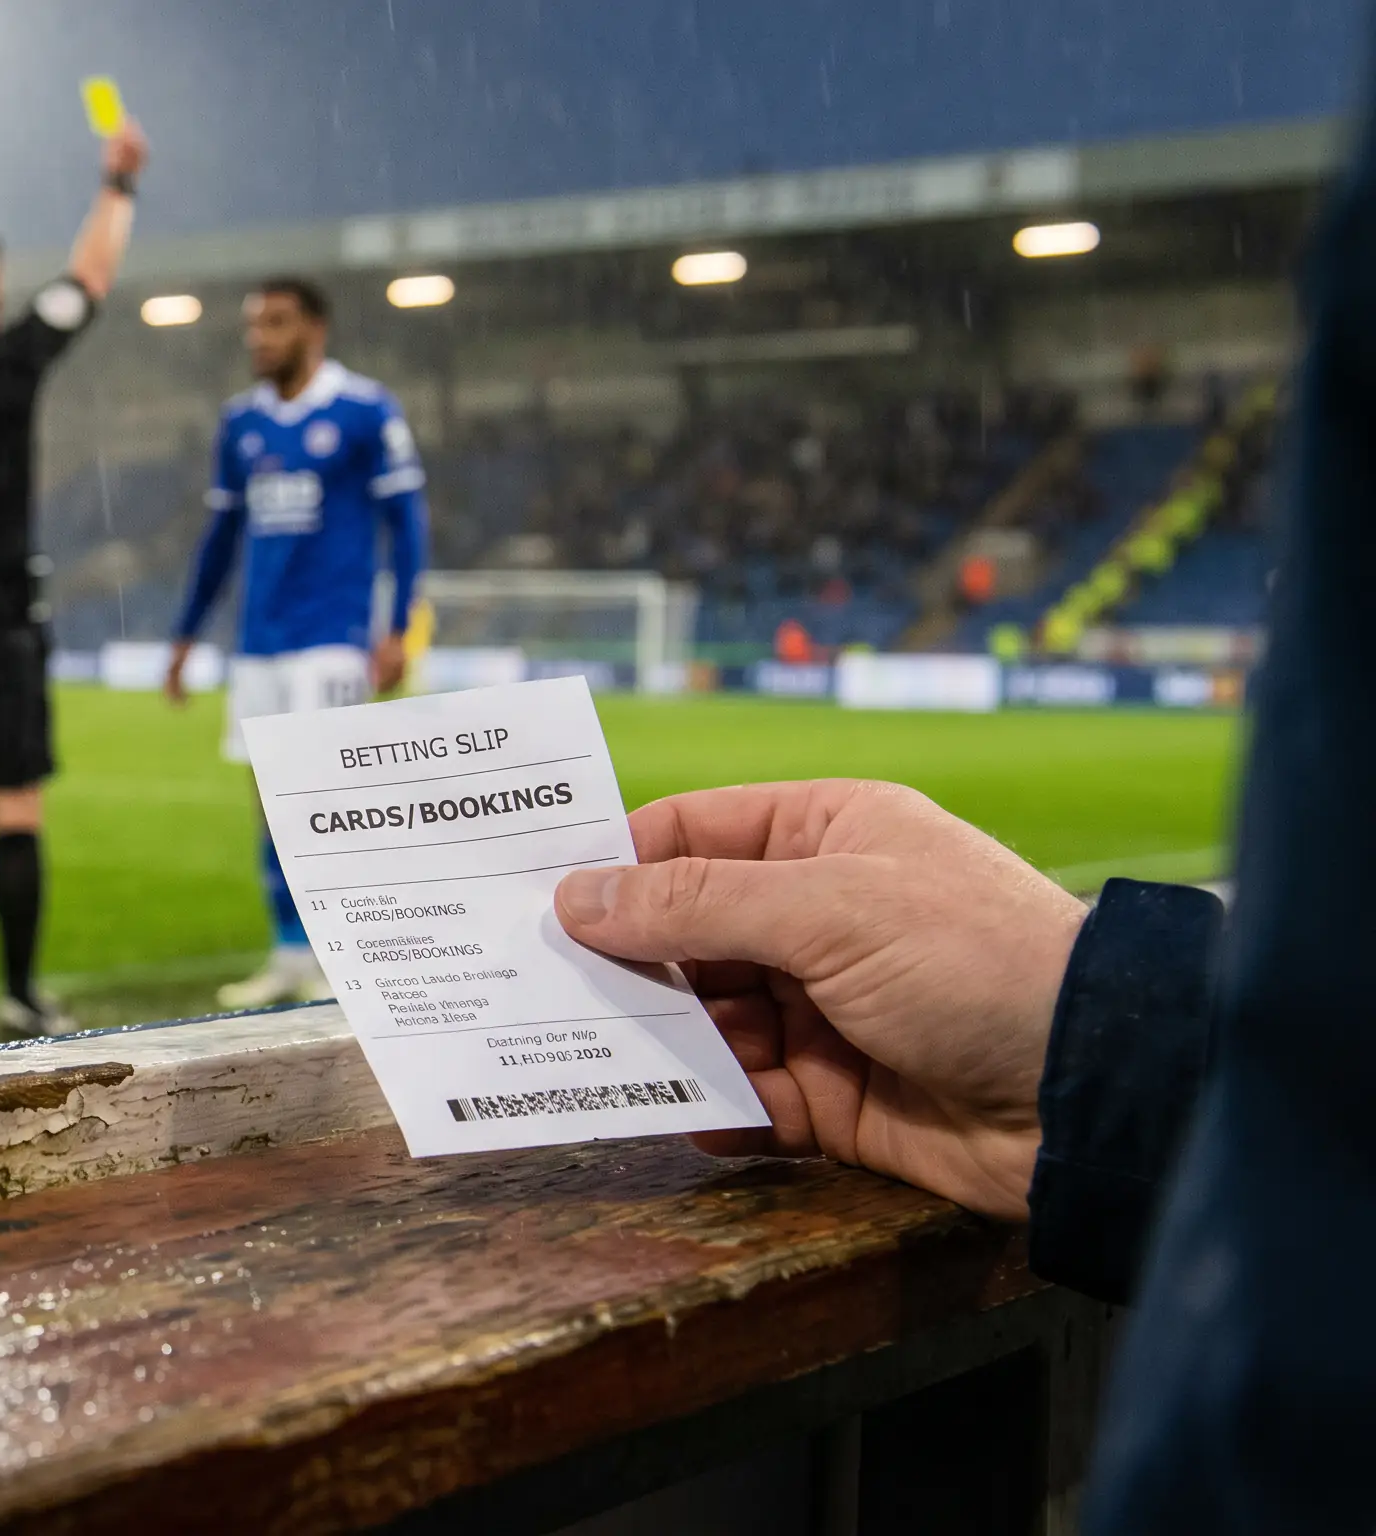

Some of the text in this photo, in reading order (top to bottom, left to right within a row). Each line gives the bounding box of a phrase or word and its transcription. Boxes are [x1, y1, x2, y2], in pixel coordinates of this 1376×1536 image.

[340, 727, 509, 769] BETTING SLIP
[309, 782, 574, 834] CARDS/BOOKINGS
[311, 900, 327, 911] 11
[345, 903, 467, 924] CARDS/BOOKINGS
[327, 941, 344, 952] 12
[362, 943, 484, 964] CARDS/BOOKINGS
[345, 980, 362, 991] 13
